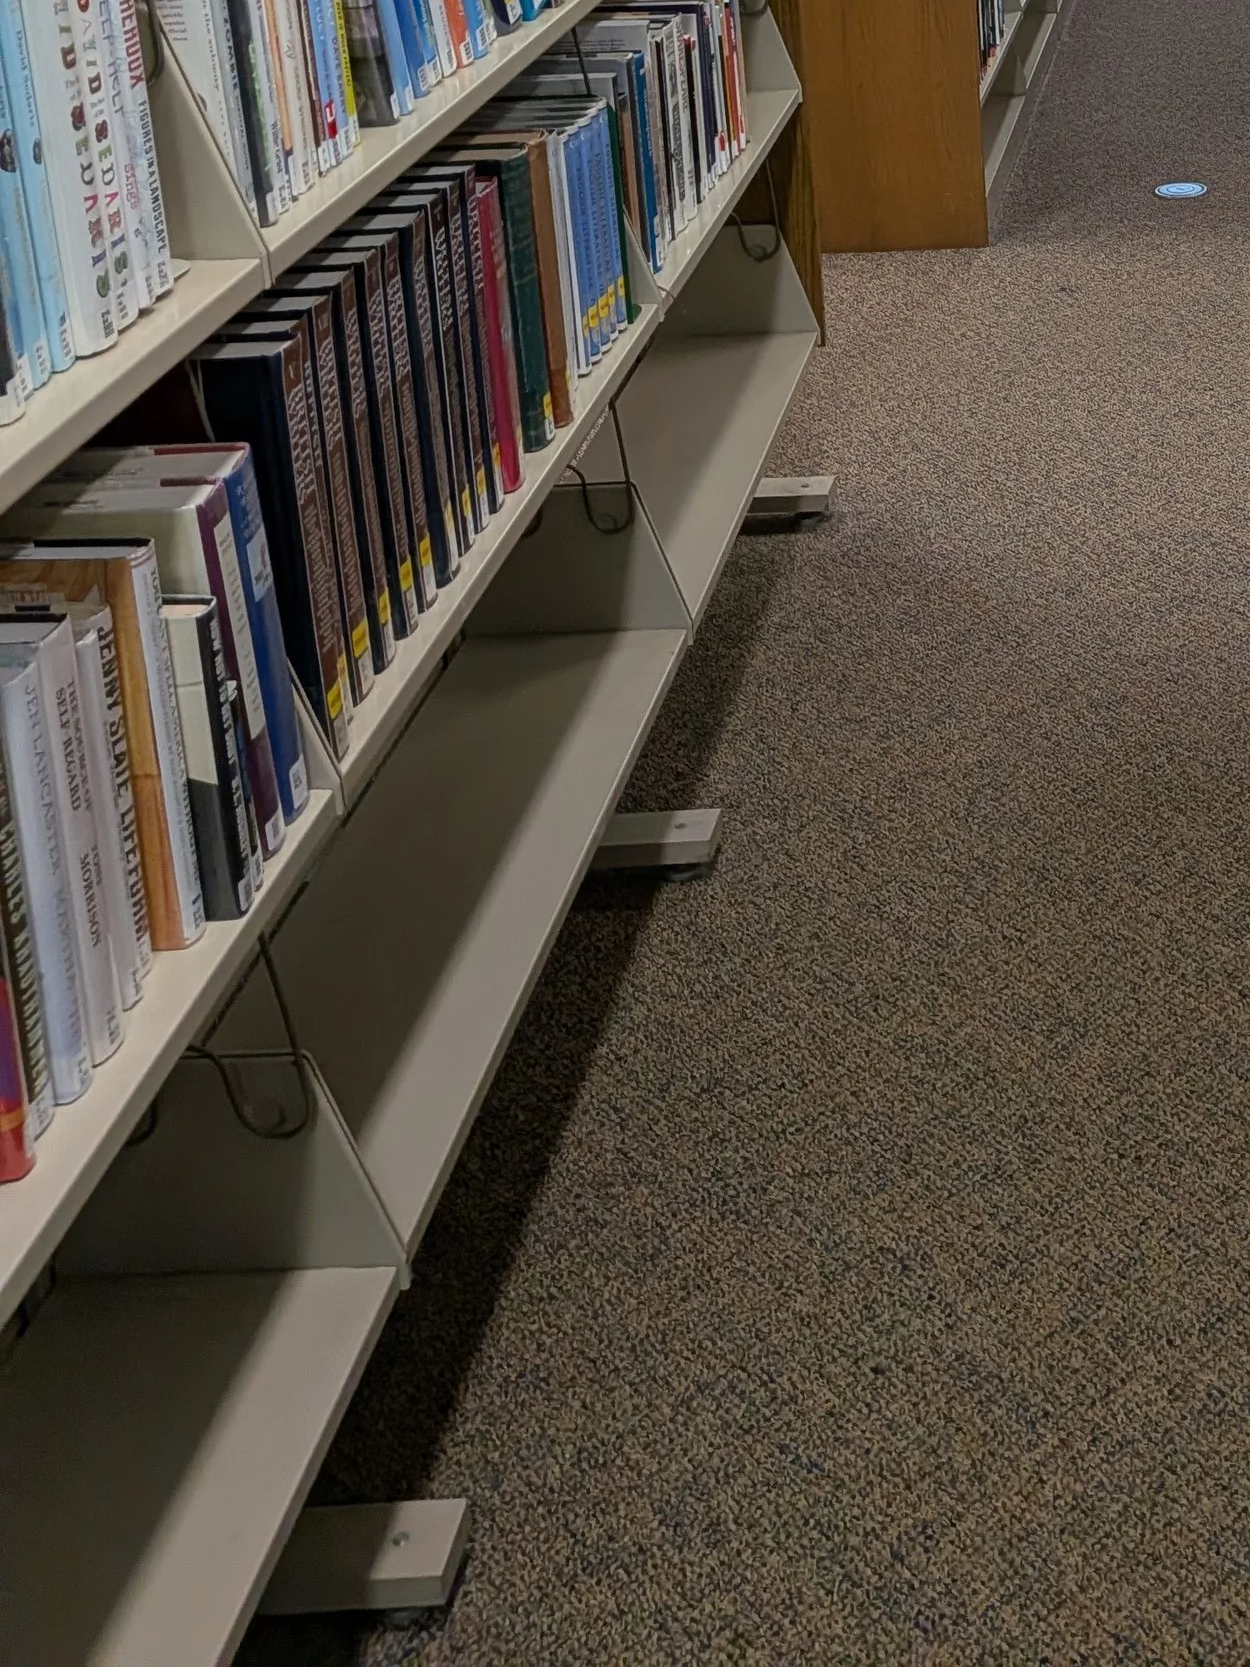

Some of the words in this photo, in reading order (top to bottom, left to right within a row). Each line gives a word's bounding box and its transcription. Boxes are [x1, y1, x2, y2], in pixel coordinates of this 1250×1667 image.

[69, 100, 110, 299] SEDARIS
[93, 117, 130, 274] SEDARIS
[137, 99, 156, 157] FIGURES
[148, 180, 168, 256] LANDSCAPE
[25, 684, 40, 732] JEN
[55, 688, 70, 731] SELF
[99, 621, 123, 713] JENNY
[62, 734, 82, 812] REGARD
[109, 714, 133, 796] SLATE
[31, 736, 62, 875] LANCASTER
[79, 851, 101, 948] MORRISON
